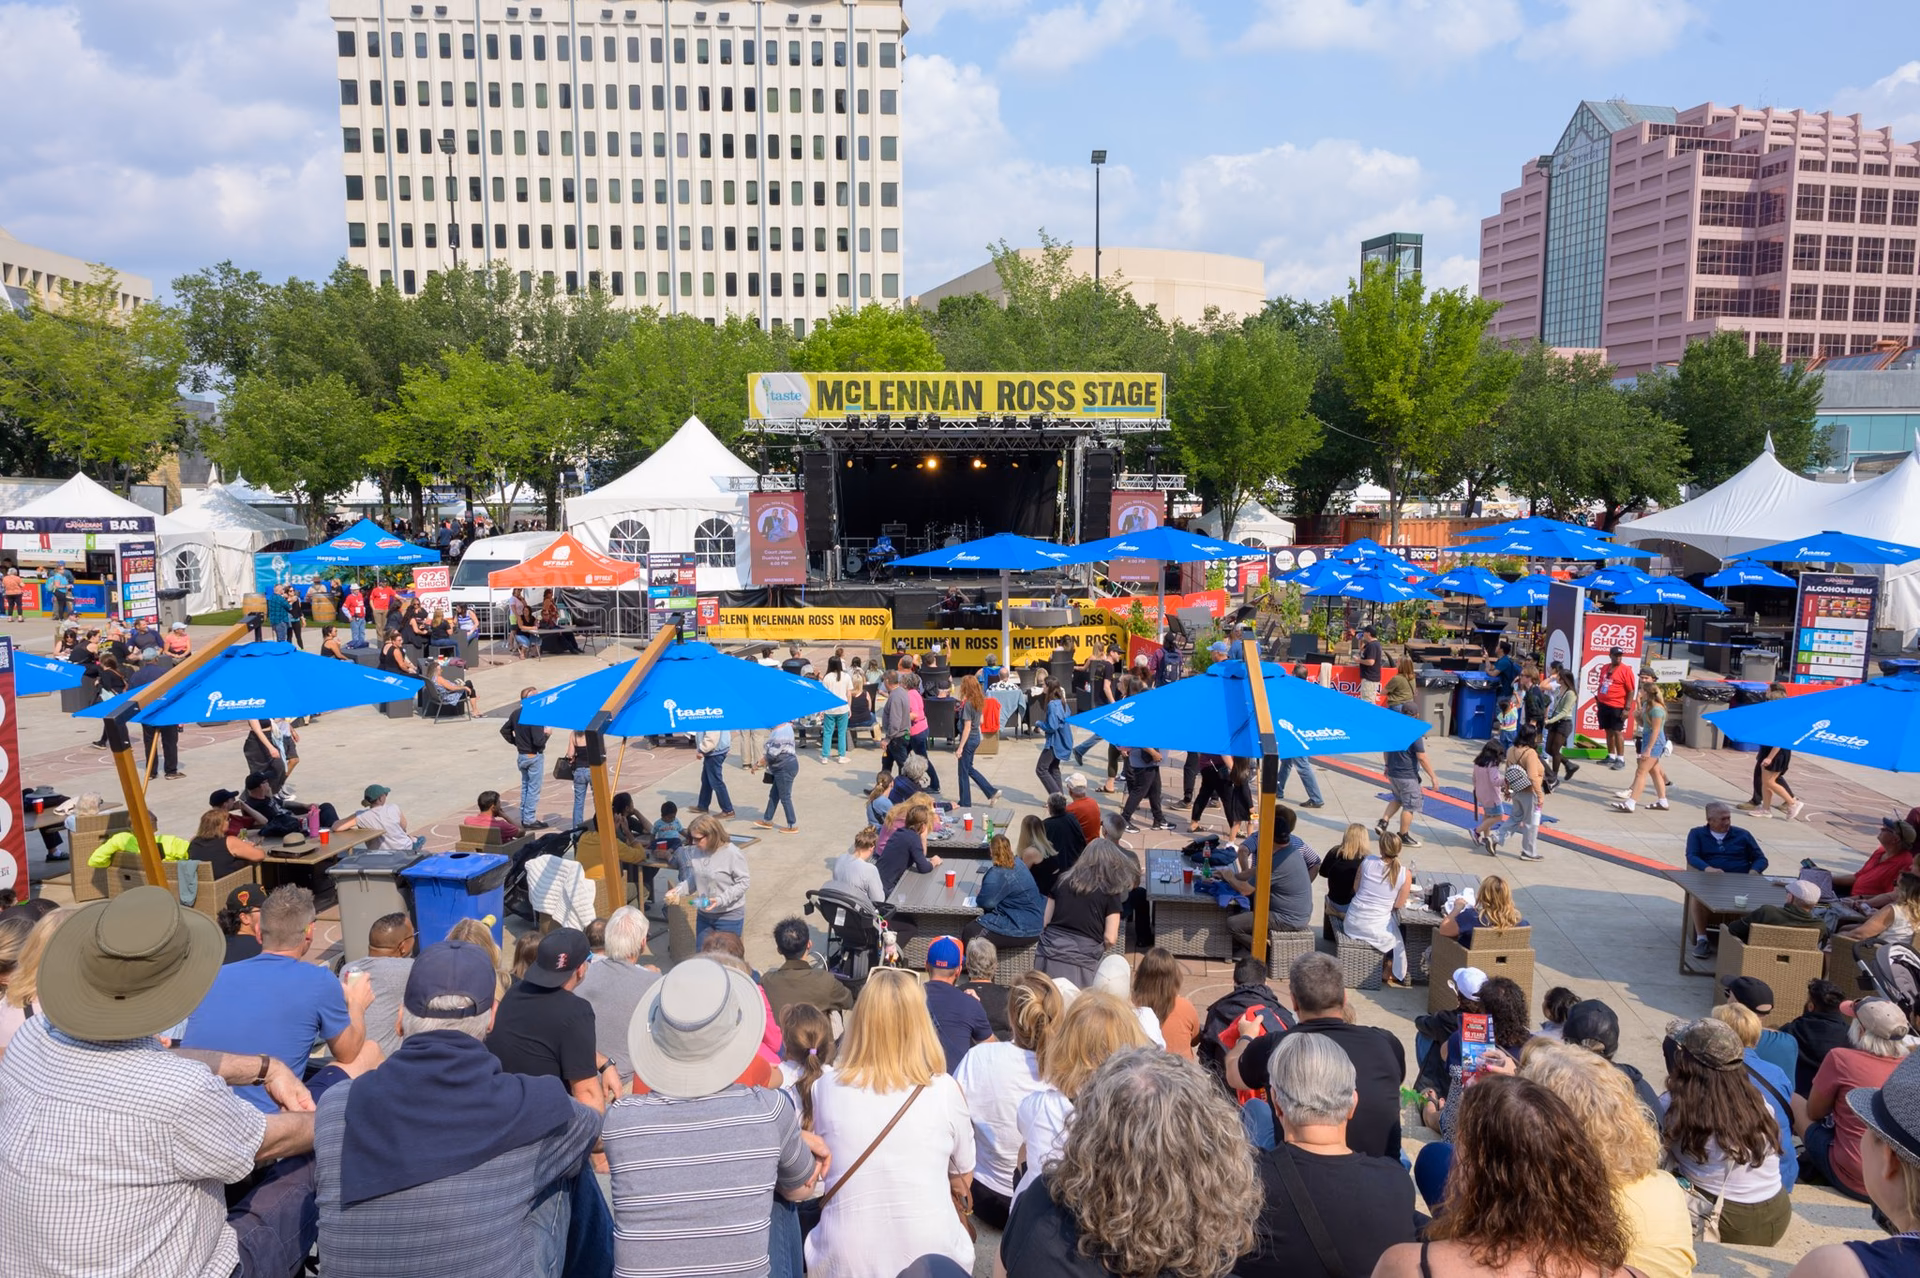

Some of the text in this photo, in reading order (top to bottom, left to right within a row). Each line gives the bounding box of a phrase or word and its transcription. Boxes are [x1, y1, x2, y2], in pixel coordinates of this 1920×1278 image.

[770, 390, 802, 400] taste
[997, 380, 1076, 411] ROSS
[1082, 382, 1156, 406] STAGE
[6, 520, 34, 530] BAR
[110, 520, 138, 530] BAR
[422, 572, 446, 581] 92.5
[809, 615, 834, 625] ROSS
[860, 615, 884, 625] ROSS
[1600, 626, 1635, 639] 92.5
[966, 637, 998, 650] ROSS
[1086, 634, 1117, 646] ROSS
[1593, 638, 1634, 648] CHUCK
[218, 698, 266, 707] taste
[675, 707, 724, 716] taste
[1297, 727, 1346, 738] taste
[1815, 730, 1869, 746] taste
